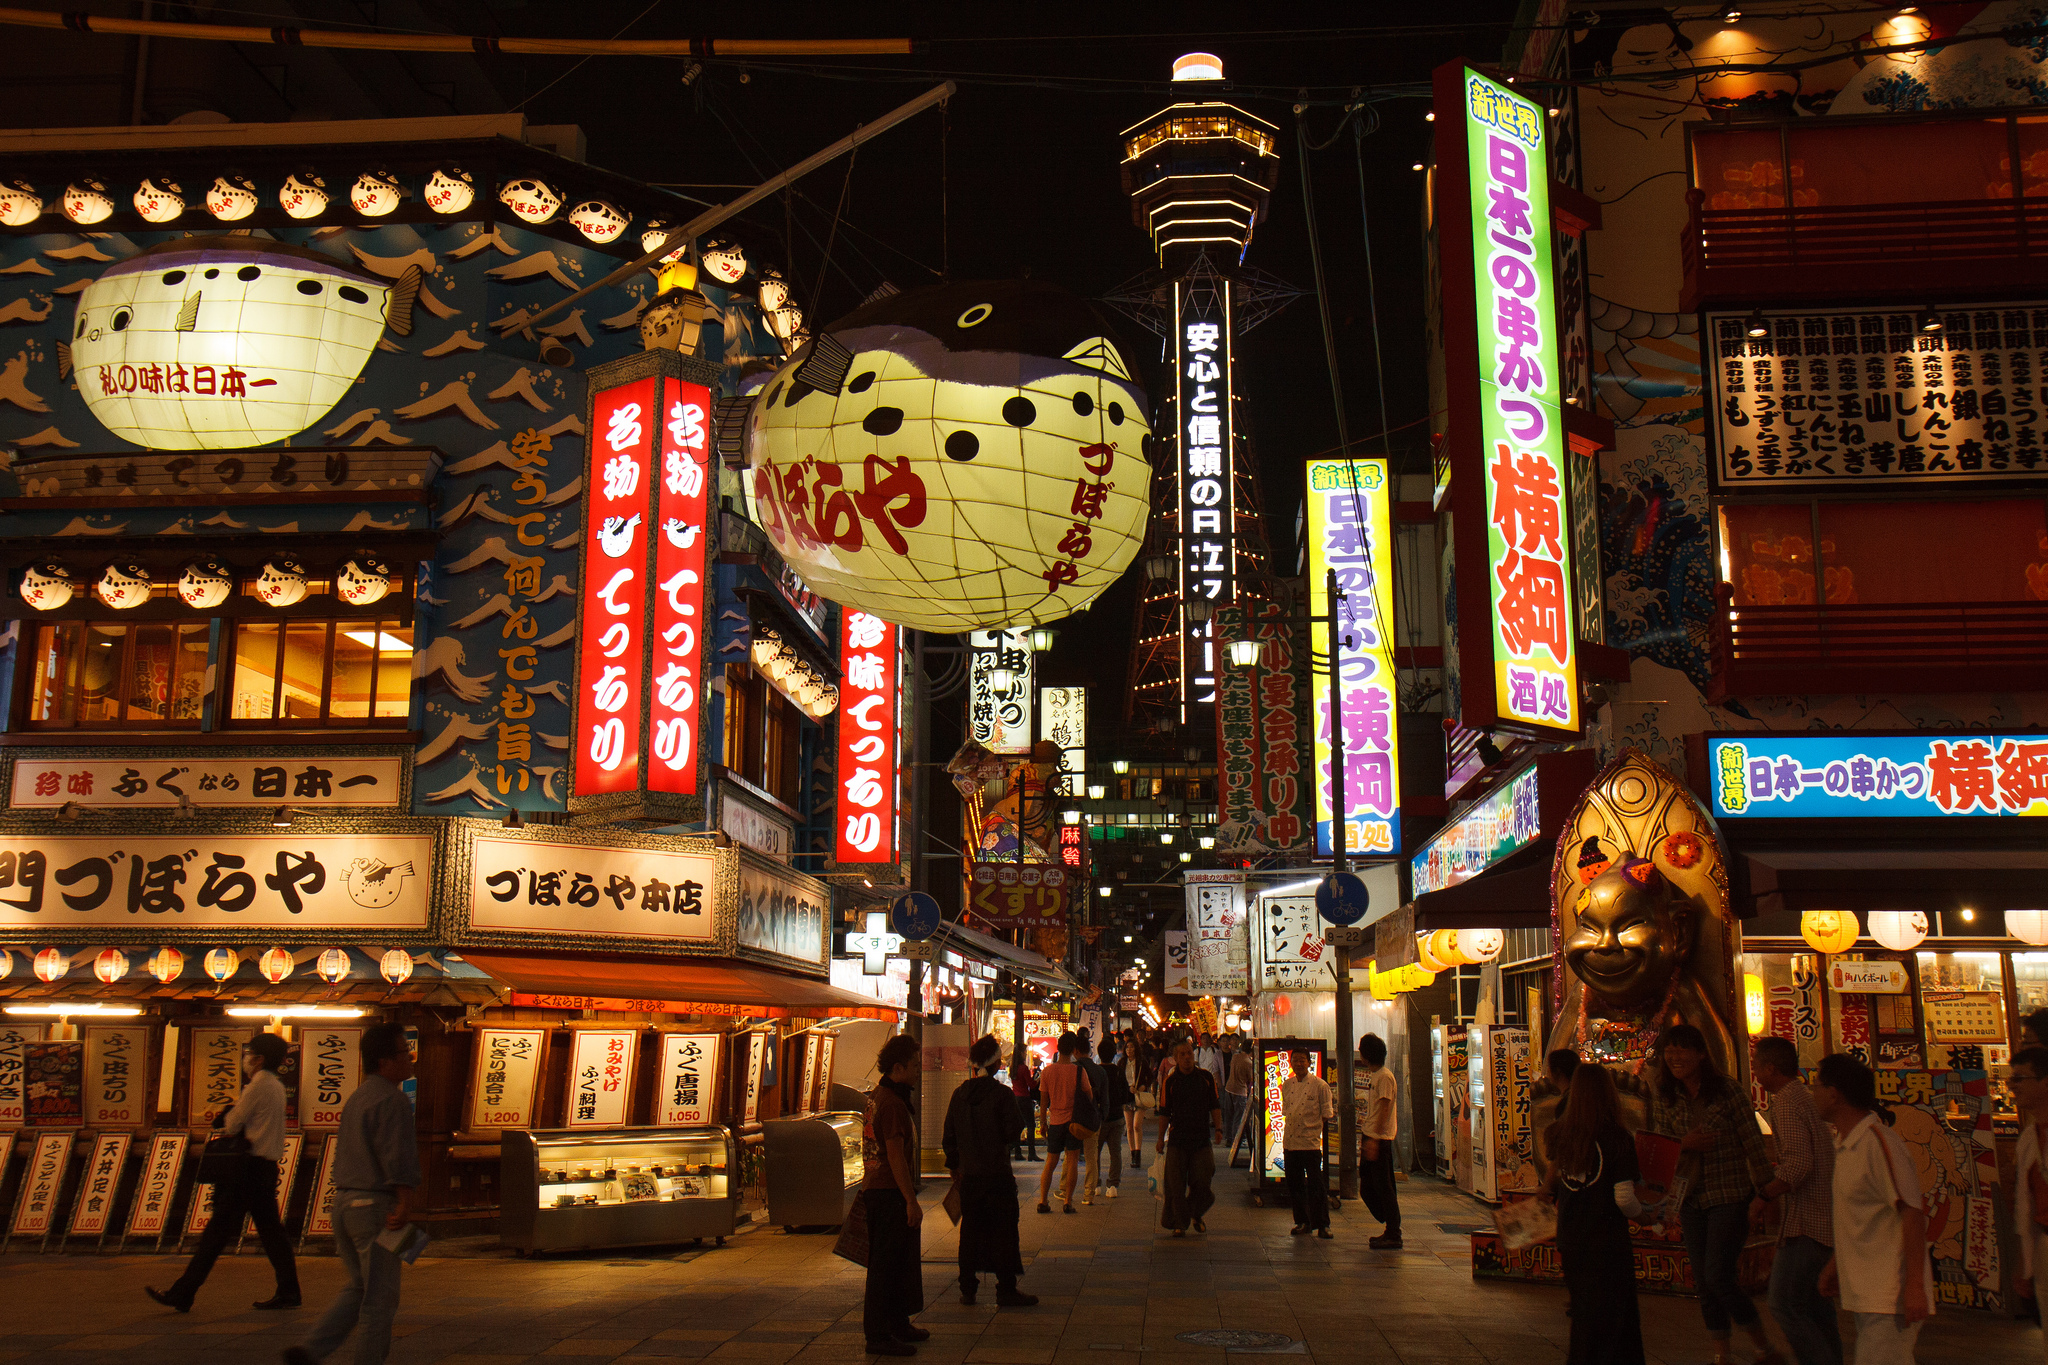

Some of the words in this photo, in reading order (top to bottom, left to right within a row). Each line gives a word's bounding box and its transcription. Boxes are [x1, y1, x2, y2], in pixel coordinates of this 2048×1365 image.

[1469, 81, 1540, 148] 新世界
[1486, 134, 1545, 442] 日本一の串かつ
[99, 363, 279, 398] 私の味は日本一
[602, 401, 642, 500] 名物
[665, 400, 705, 499] 名物
[1725, 396, 1752, 476] もち
[1753, 395, 1783, 475] うずら玉子
[1780, 394, 1812, 474] 紅しょうが
[1808, 394, 1837, 474] にんにく
[1837, 393, 1868, 474] 玉ねぎ
[1865, 392, 1896, 473] 山芋
[1895, 391, 1926, 472] しし唐
[1922, 390, 1955, 471] れんこん
[1981, 388, 2013, 471] 白ねぎ
[2010, 387, 2043, 470] さつま芋
[755, 453, 927, 556] づぼらや
[1043, 442, 1115, 593] づぼらや
[1311, 464, 1382, 491] 新世界
[1324, 494, 1377, 682] 日本一の串かつ
[1490, 444, 1570, 667] 横綱
[496, 427, 553, 795] 安うて何んでも旨い
[591, 567, 635, 774] てっちり
[655, 568, 699, 771] てっちり
[1509, 668, 1570, 721] 酒処
[845, 612, 887, 853] 珍味てっちり
[1257, 602, 1301, 849] 大小宴会承り中
[1319, 689, 1392, 818] 横綱
[1721, 745, 1747, 812] 新世界
[1749, 757, 1925, 799] 日本一の串かつ
[485, 867, 704, 916] づぼらや本店
[974, 883, 1062, 917] くすり
[853, 936, 899, 951] くすり
[1793, 972, 1819, 1038] ソースの
[102, 1032, 131, 1103] ふぐ皮ちり
[317, 1034, 346, 1105] ふぐにぎり
[577, 1066, 600, 1120] ふぐ料理
[602, 1038, 625, 1092] おみやげ
[672, 1040, 704, 1106] ふぐ唐揚
[0, 1107, 22, 1117] 40
[1514, 1063, 1532, 1160] ビアガーデン
[88, 1140, 120, 1213] 天丼定食
[145, 1139, 178, 1213] 豚ひれかつ定食
